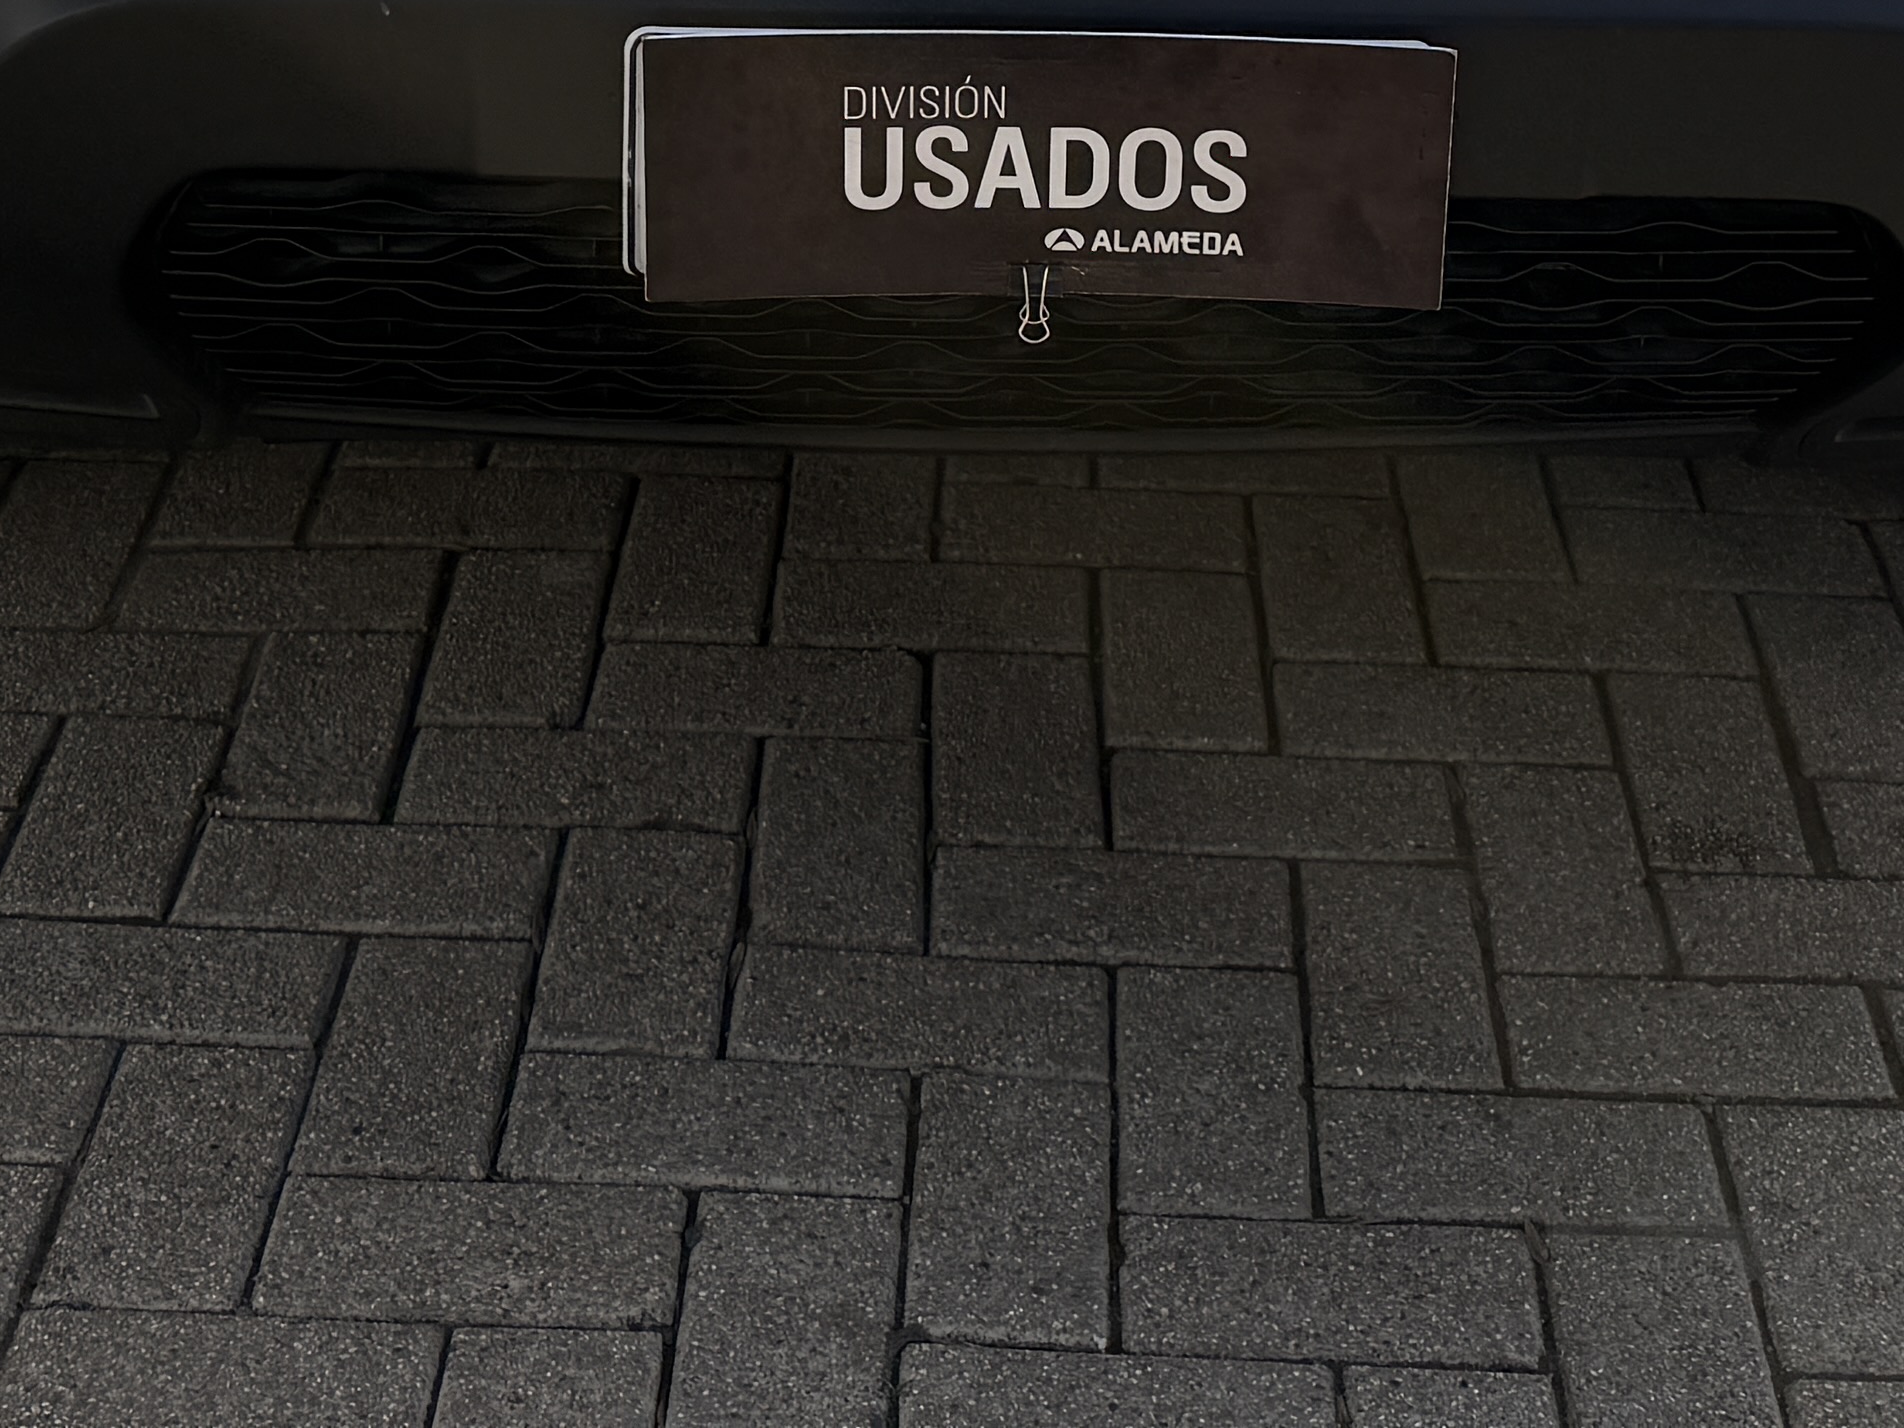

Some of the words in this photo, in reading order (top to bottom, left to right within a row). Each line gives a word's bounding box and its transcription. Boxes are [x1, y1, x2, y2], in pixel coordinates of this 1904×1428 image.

[843, 75, 1006, 120] DIVISIÓN
[844, 125, 1248, 213] USADOS
[1091, 229, 1244, 256] ALAMEDA
